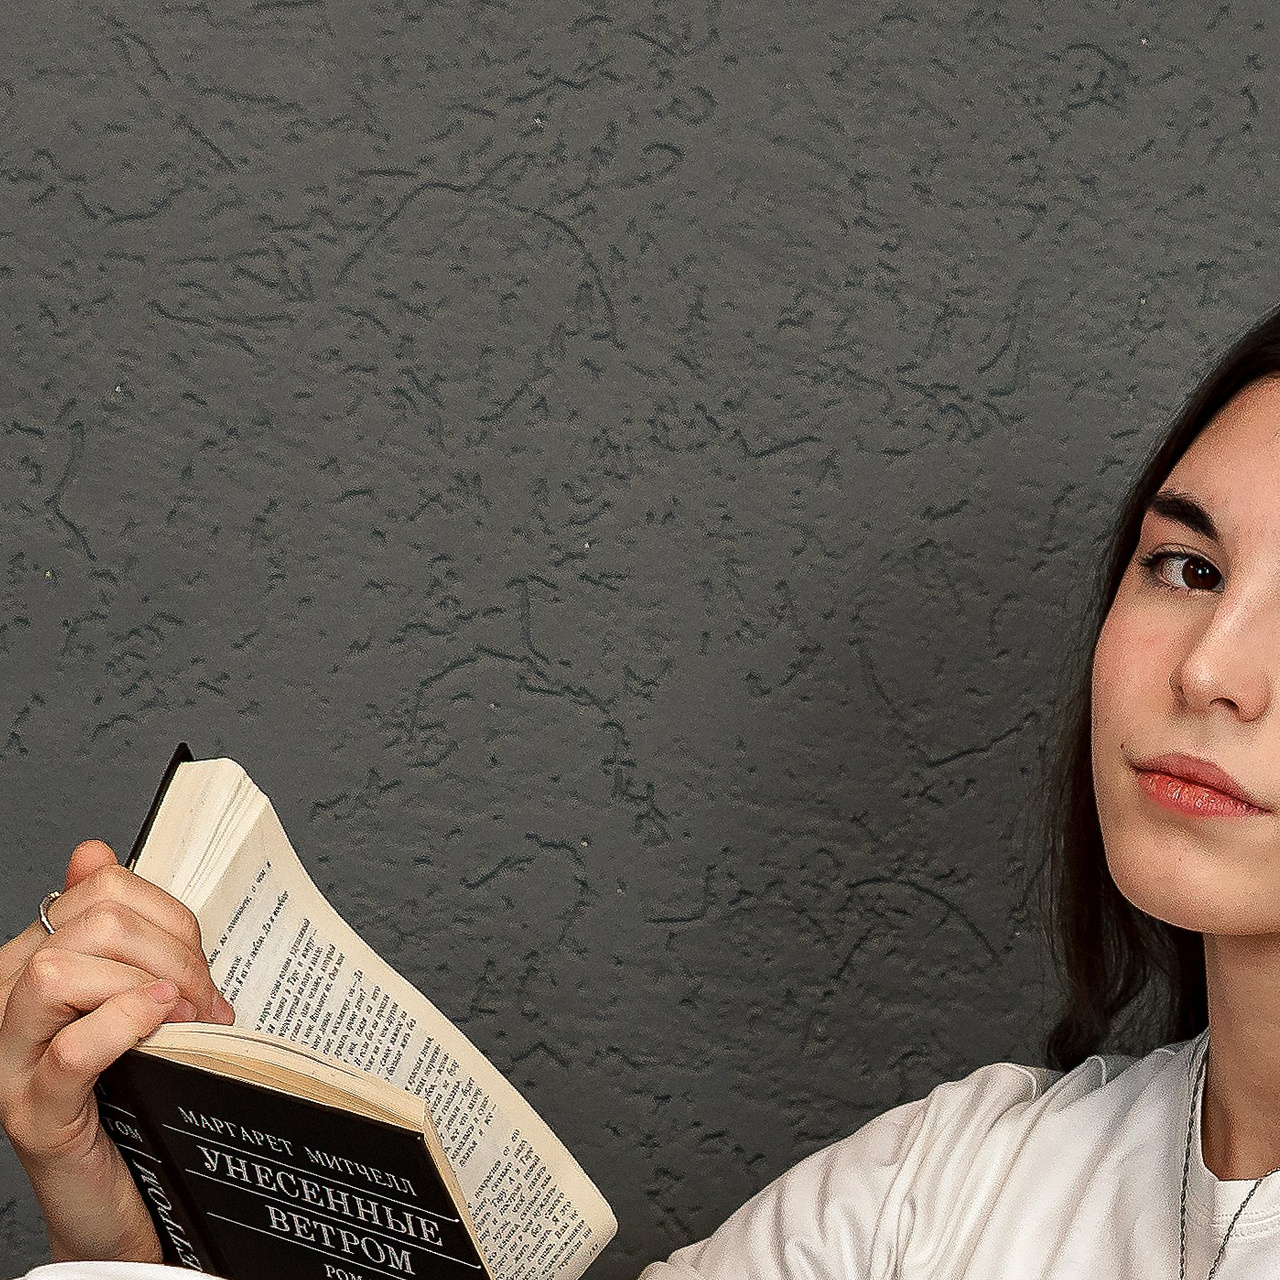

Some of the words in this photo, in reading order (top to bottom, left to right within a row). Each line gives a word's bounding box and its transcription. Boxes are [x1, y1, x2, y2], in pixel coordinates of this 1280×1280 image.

[101, 1115, 143, 1143] ТОМ
[178, 1107, 295, 1156] МАРГАРЕТ
[306, 1145, 418, 1197] МИТЧЕЛЛ
[197, 1145, 444, 1247] УНЕСЕННЫЕ
[265, 1204, 416, 1275] ВЕТРОМ
